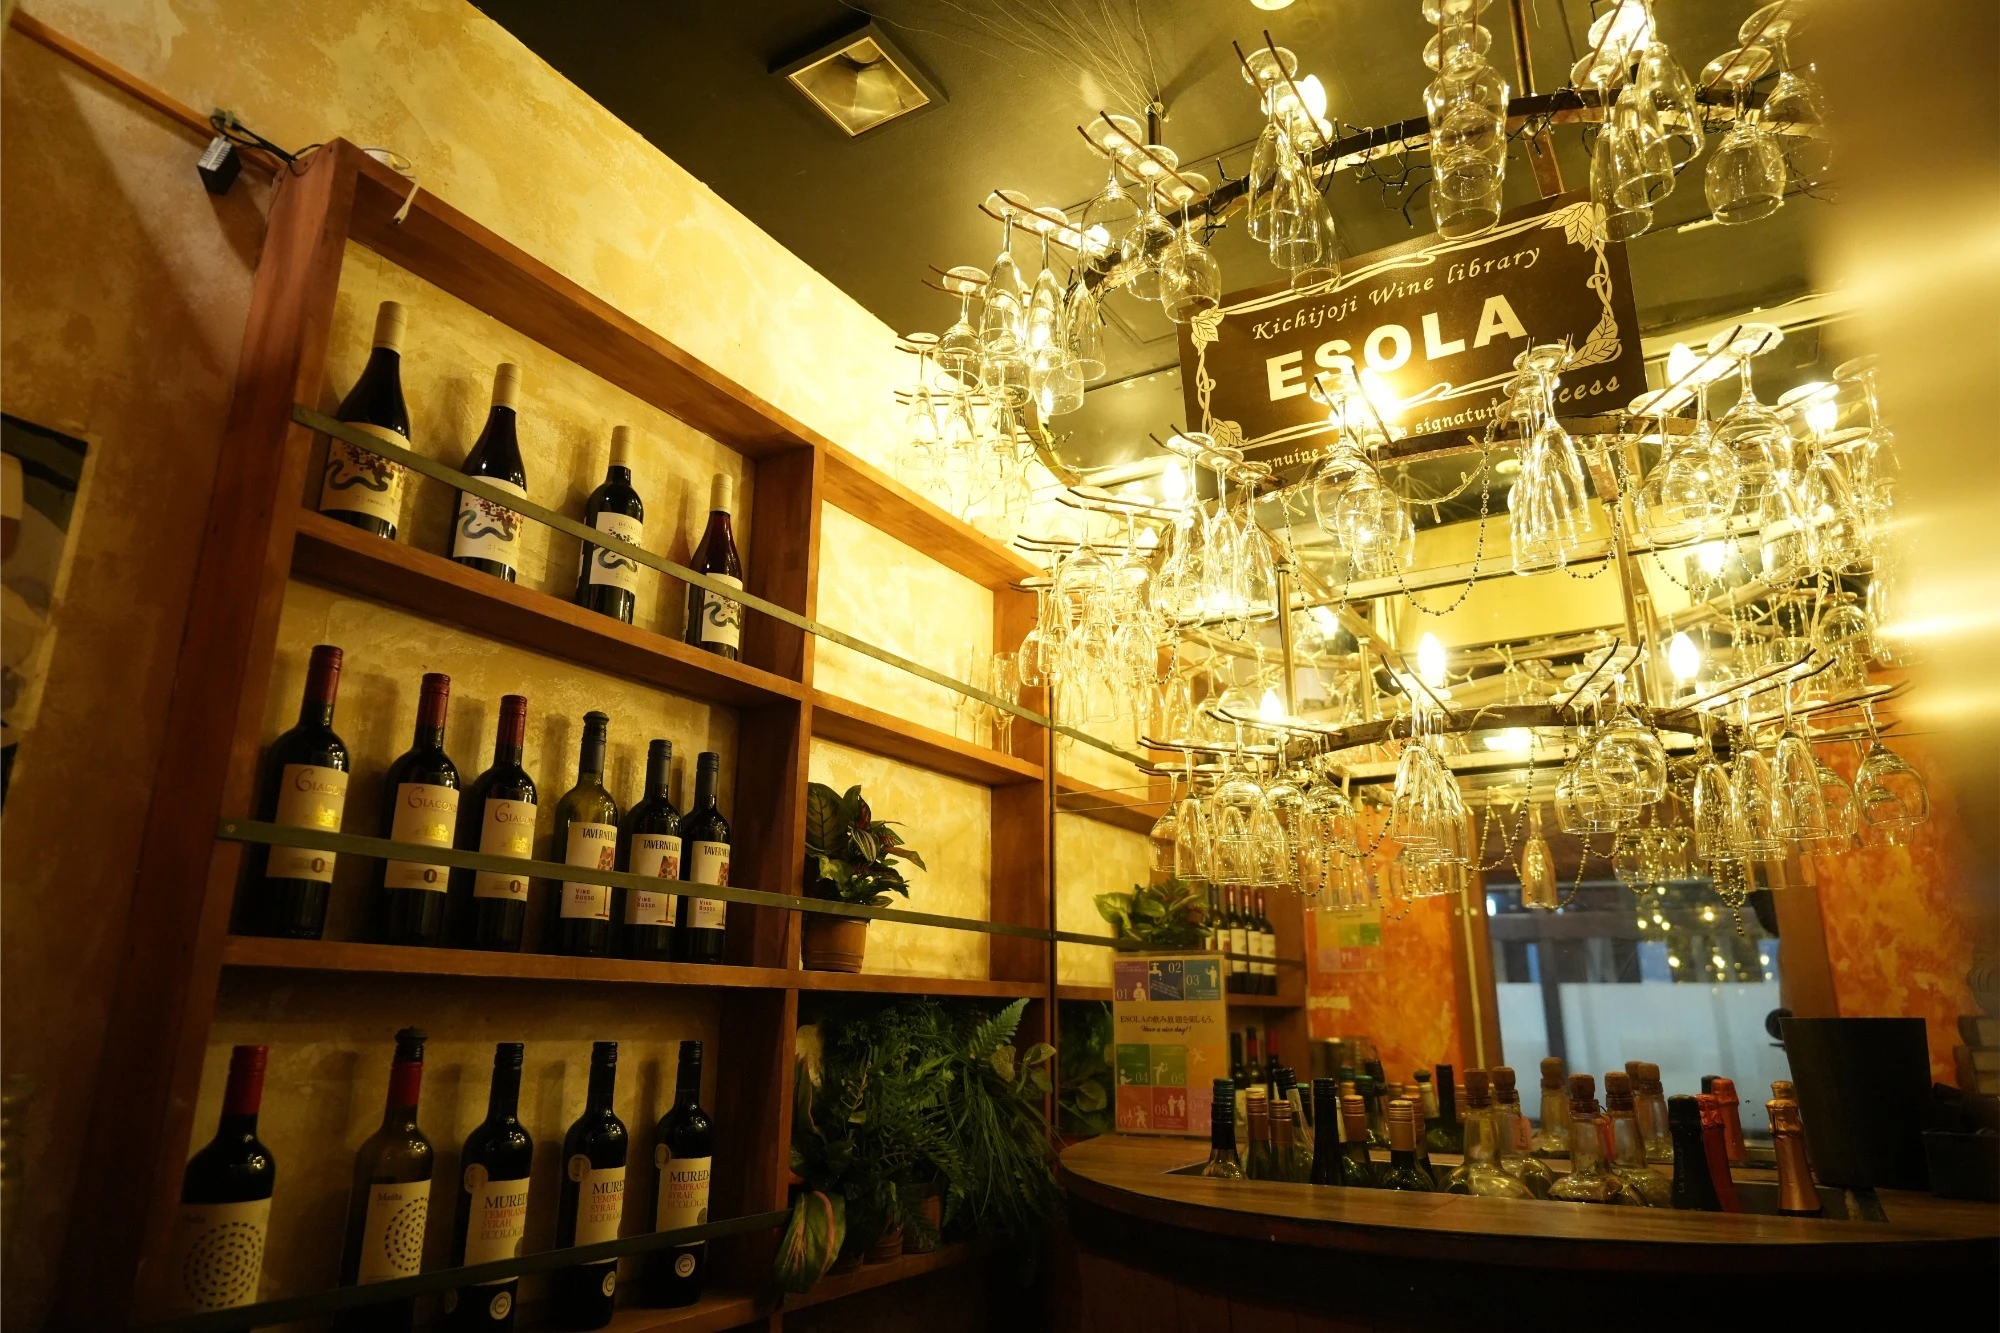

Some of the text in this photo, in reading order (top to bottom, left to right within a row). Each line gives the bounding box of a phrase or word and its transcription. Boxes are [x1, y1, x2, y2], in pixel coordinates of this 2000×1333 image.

[1252, 247, 1540, 340] Kichijoji Wine library
[1265, 294, 1528, 402] ESOLA
[1168, 962, 1182, 973] 02
[1186, 974, 1200, 986] 03
[1116, 988, 1128, 1000] 01
[1135, 1072, 1149, 1083] 04
[1171, 1073, 1184, 1085] 05
[1154, 1104, 1168, 1116] 08
[1190, 1100, 1204, 1112] 09
[1119, 1114, 1133, 1127] 07
[667, 1191, 693, 1200] SYRAH
[590, 1203, 617, 1213] SYRAH
